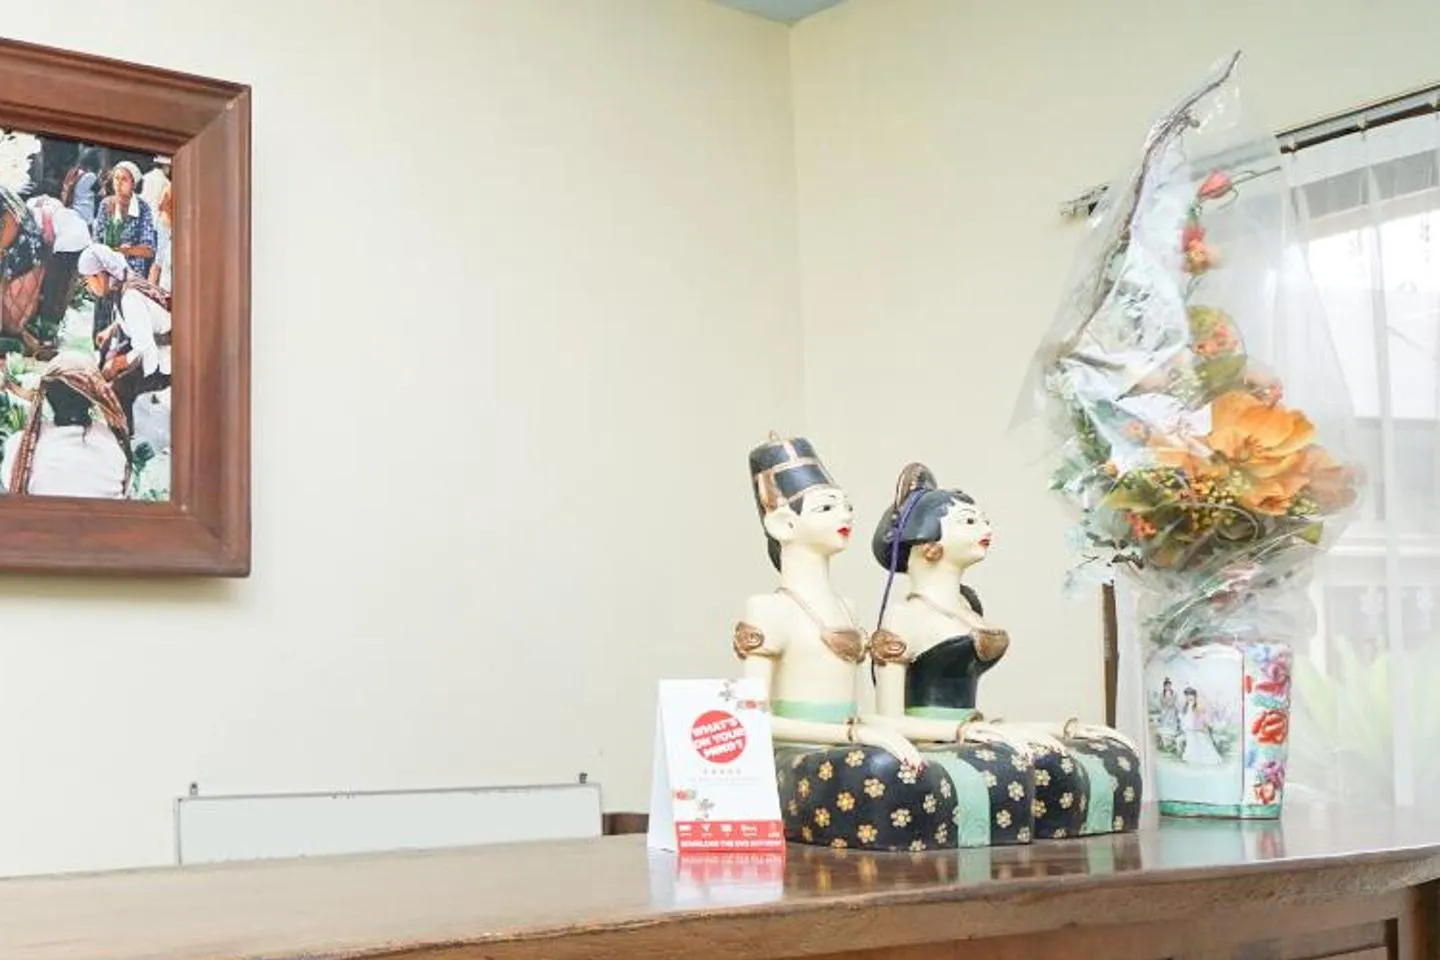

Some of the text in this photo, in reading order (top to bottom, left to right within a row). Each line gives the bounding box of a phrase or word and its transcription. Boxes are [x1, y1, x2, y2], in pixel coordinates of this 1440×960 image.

[692, 717, 738, 737] WHAT'S
[694, 727, 747, 749] ON YOUR
